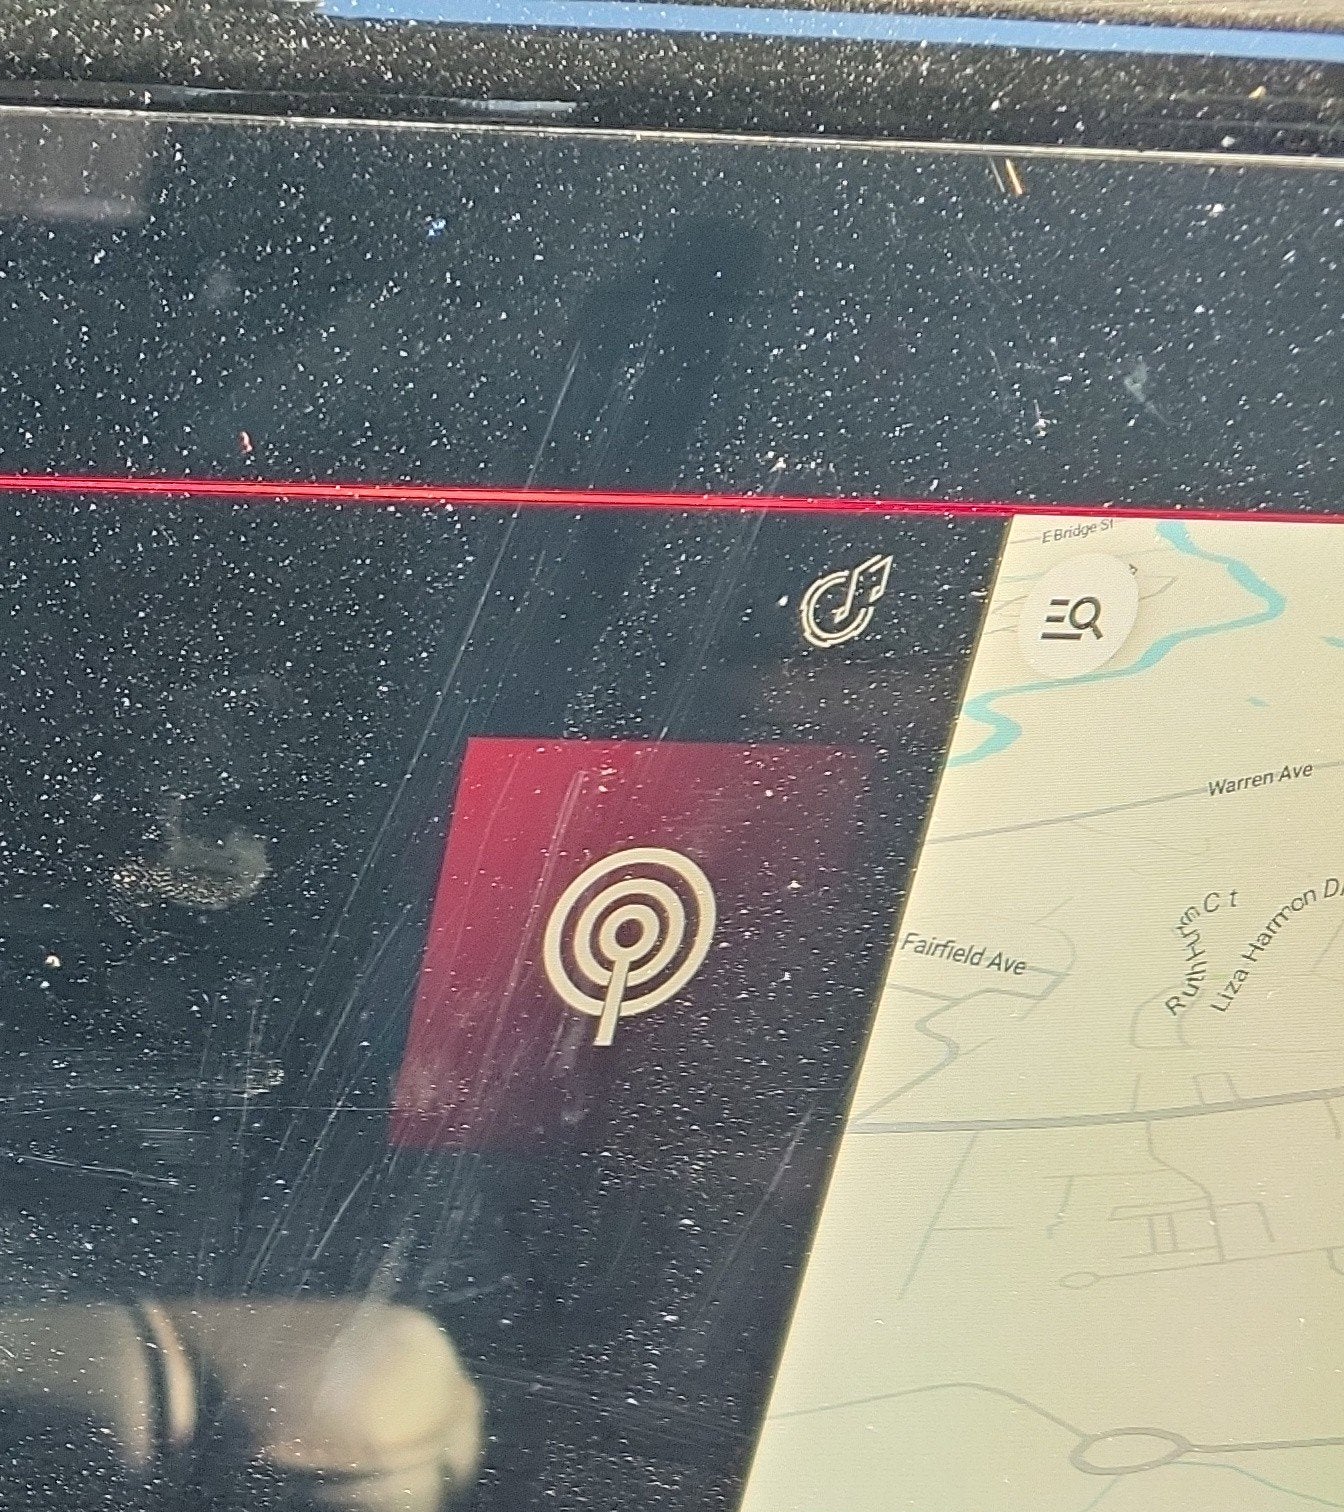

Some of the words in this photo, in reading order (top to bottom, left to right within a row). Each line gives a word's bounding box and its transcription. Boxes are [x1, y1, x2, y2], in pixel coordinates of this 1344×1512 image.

[1042, 530, 1052, 544] E
[1054, 524, 1098, 541] Bridge
[1208, 772, 1273, 796] Warren
[1279, 764, 1313, 782] Ave
[901, 932, 987, 966] Fairfield
[985, 951, 1026, 975] Ave
[1209, 969, 1250, 1012] Liza
[1241, 889, 1317, 963] Harmon
